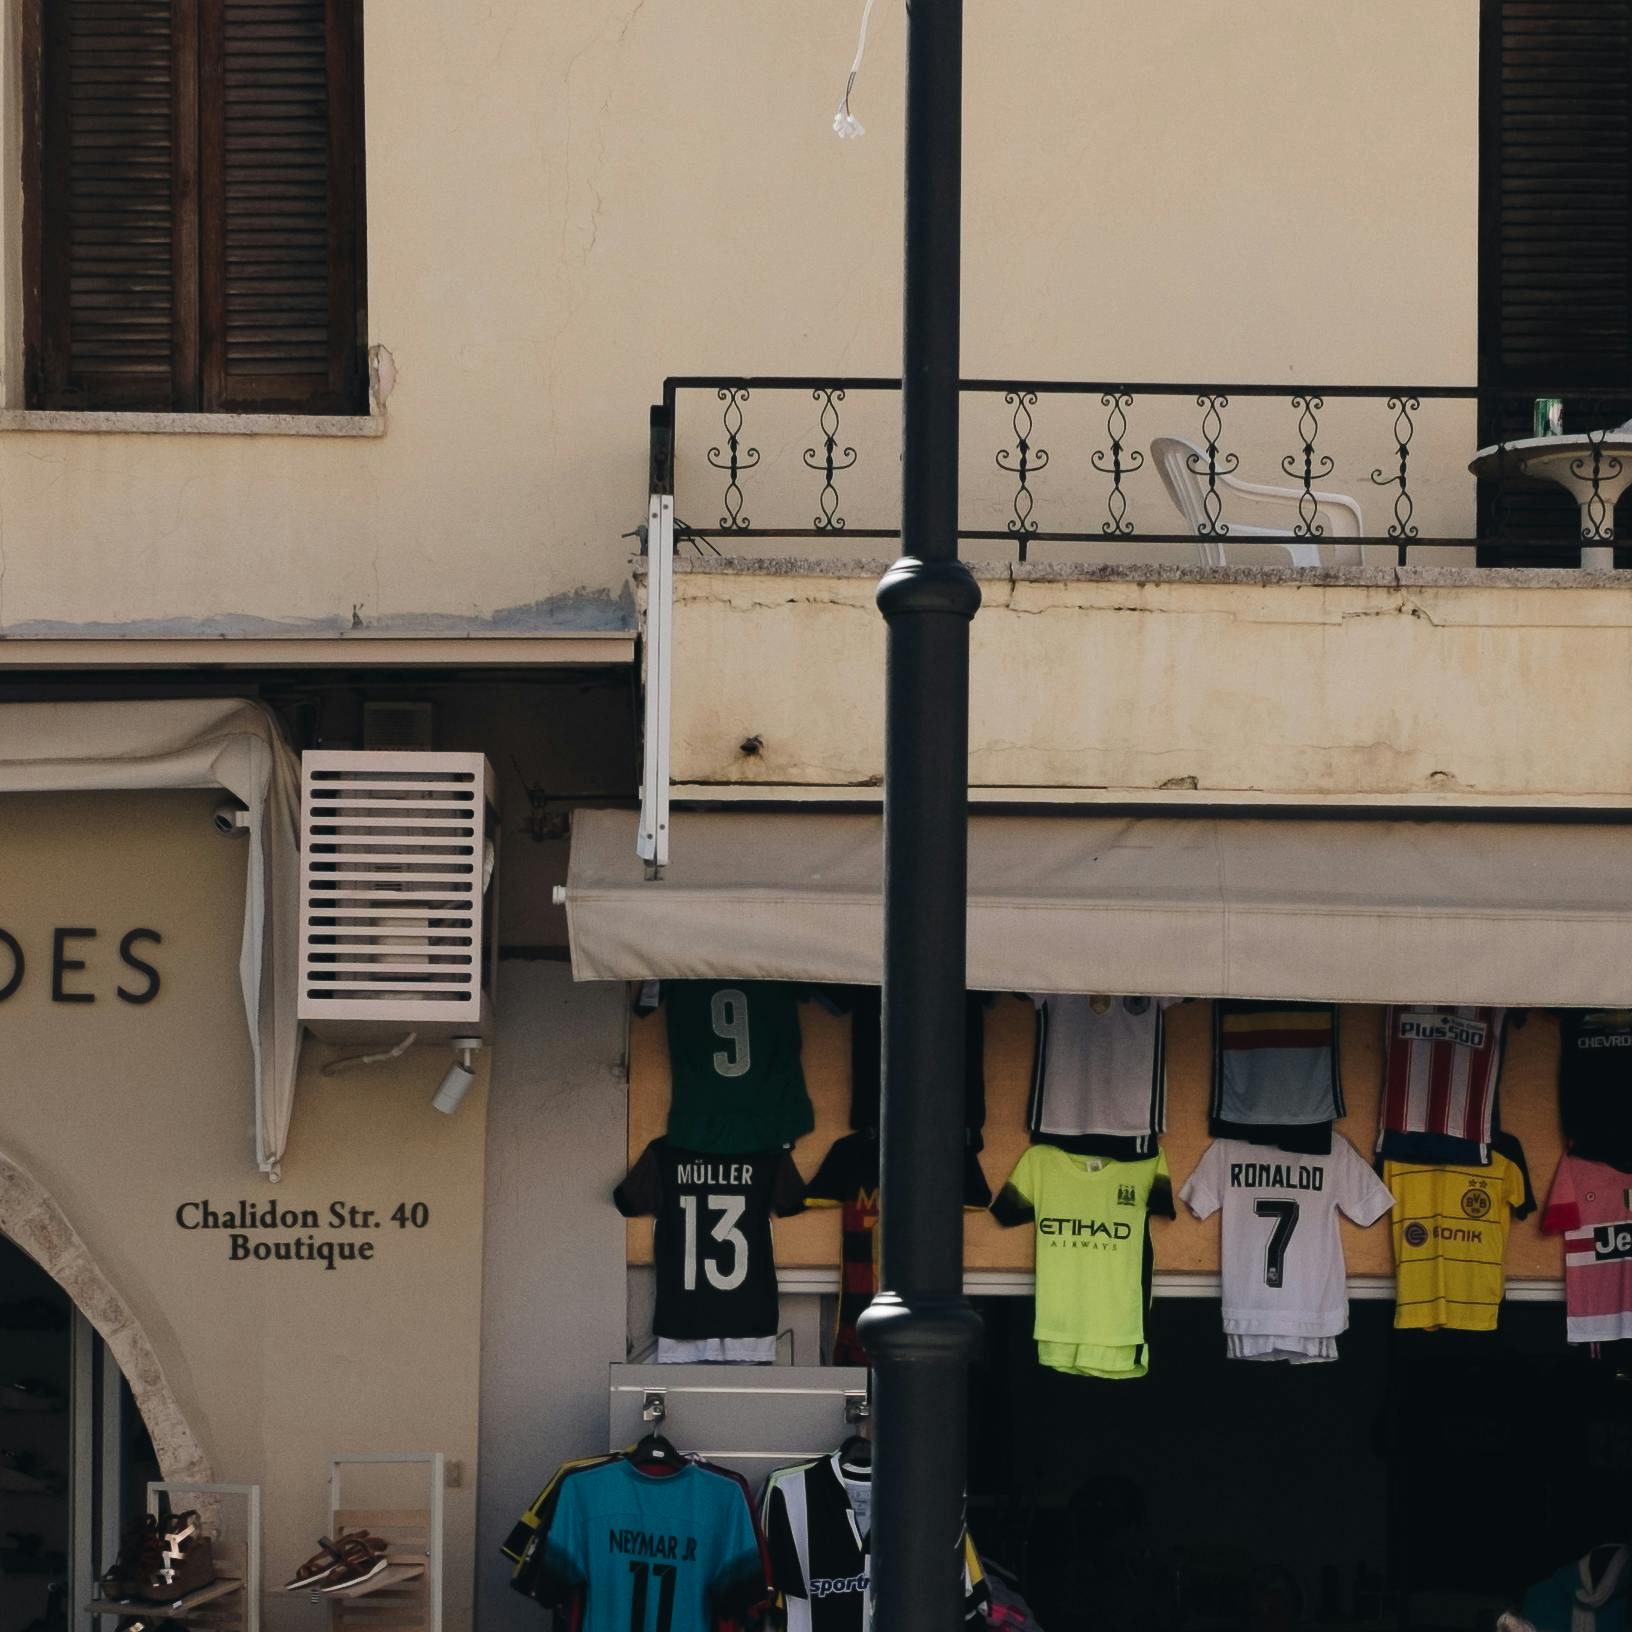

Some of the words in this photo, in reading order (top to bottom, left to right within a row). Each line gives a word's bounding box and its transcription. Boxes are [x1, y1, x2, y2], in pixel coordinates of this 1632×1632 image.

[710, 988, 751, 1077] 9
[1401, 1022, 1484, 1046] Plus500
[677, 1160, 753, 1186] MÜLLER
[1230, 1163, 1324, 1192] RONALDO
[176, 1200, 318, 1231] Chalidon
[329, 1201, 381, 1231] Str.
[390, 1202, 430, 1231] 40
[1039, 1217, 1132, 1240] ETIHAD
[228, 1234, 375, 1271] Boutique
[679, 1194, 749, 1291] 13
[1050, 1240, 1118, 1251] AIRWAYS
[1253, 1197, 1300, 1289] 7
[608, 1528, 678, 1560] NEYMAR
[682, 1534, 698, 1563] JR
